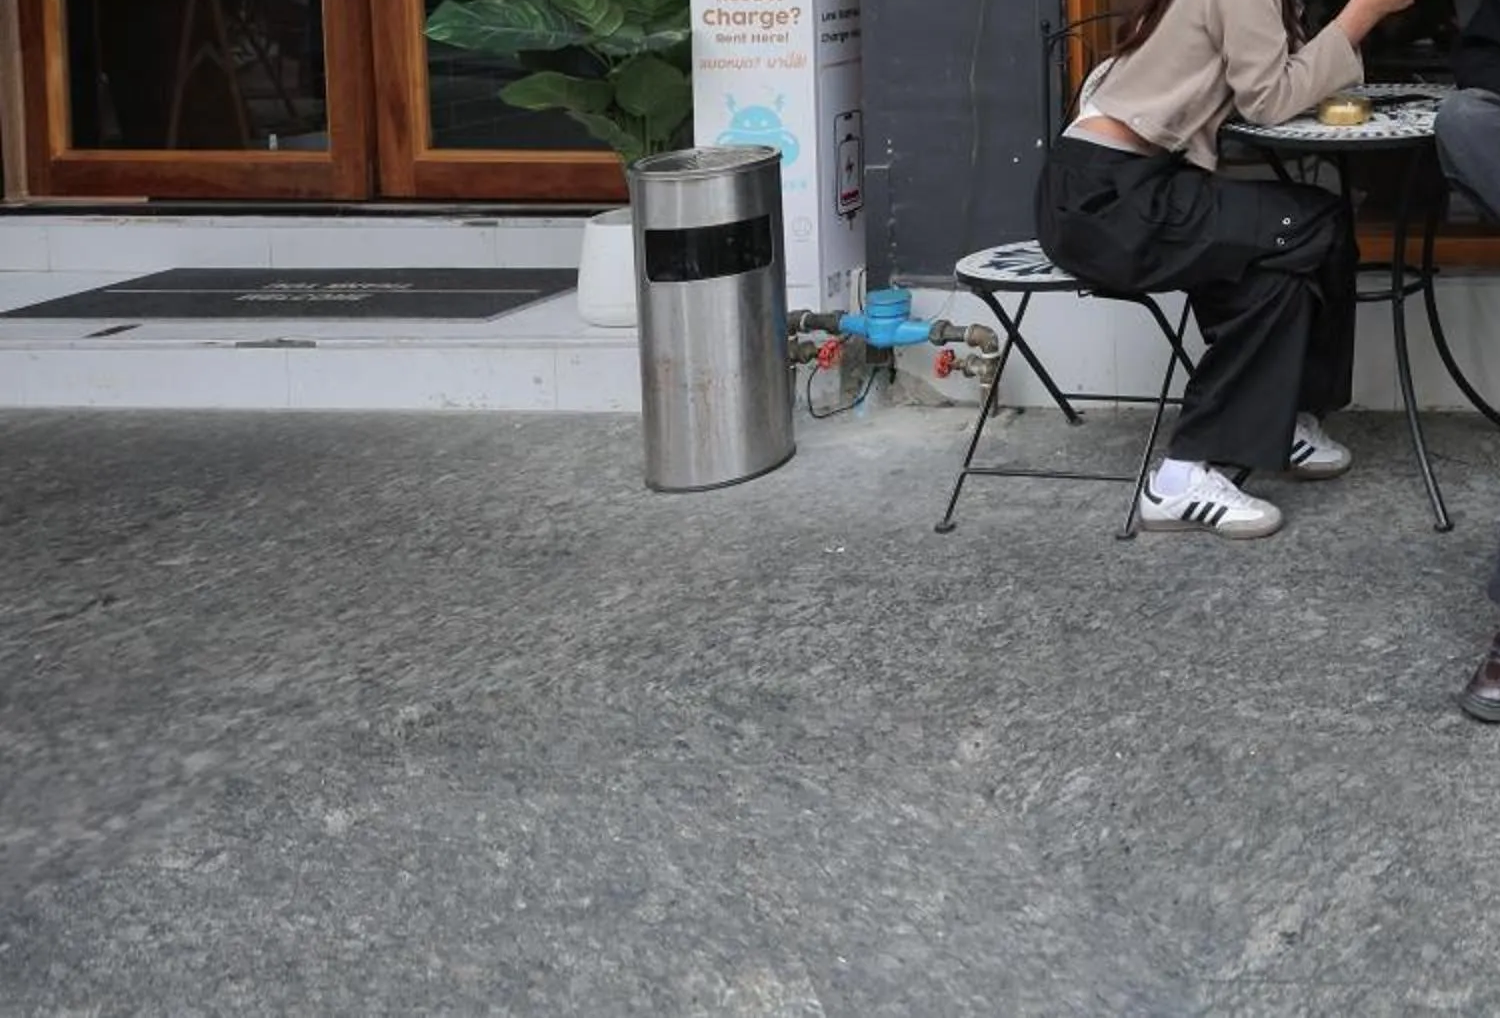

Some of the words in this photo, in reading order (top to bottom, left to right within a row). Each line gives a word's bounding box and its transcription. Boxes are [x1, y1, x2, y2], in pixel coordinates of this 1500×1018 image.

[702, 7, 802, 29] Charge?
[715, 33, 747, 43] Rent
[751, 32, 790, 43] Here!
